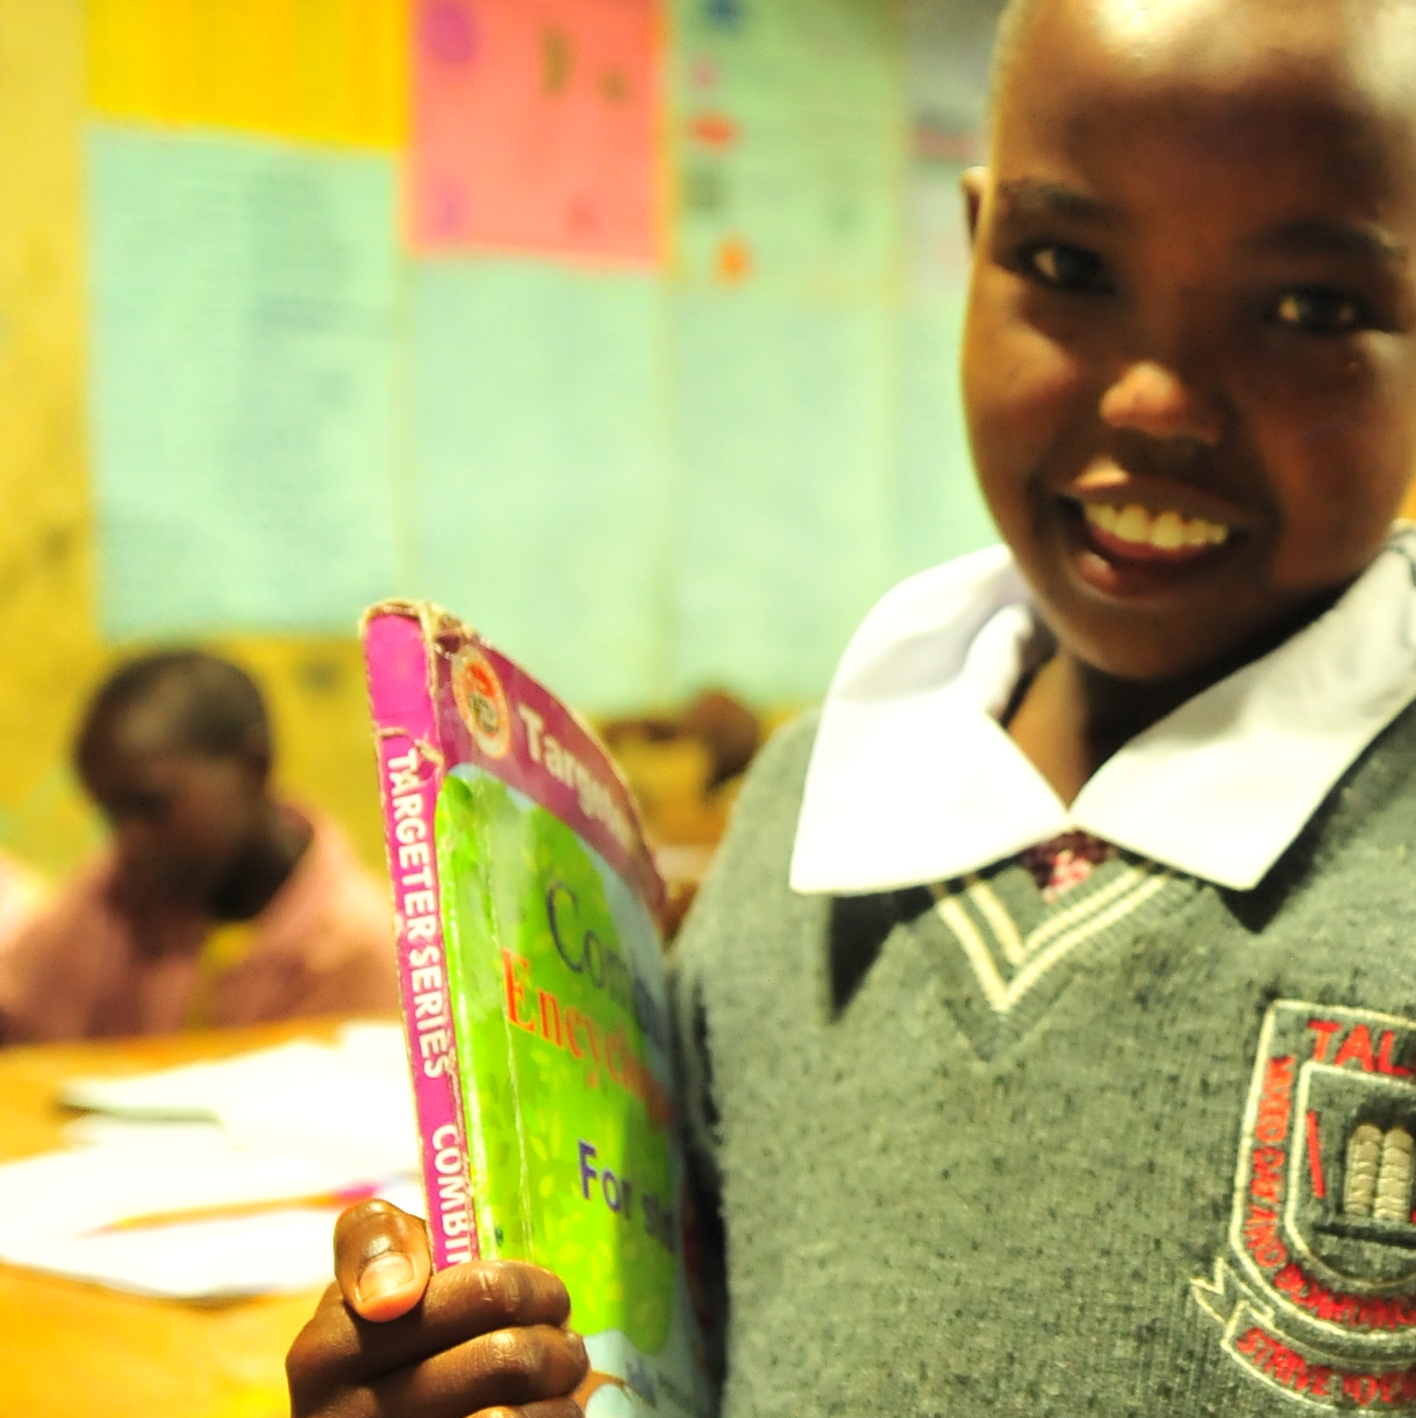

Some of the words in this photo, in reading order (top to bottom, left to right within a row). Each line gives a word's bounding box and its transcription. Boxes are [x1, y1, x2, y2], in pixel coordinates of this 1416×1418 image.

[386, 748, 436, 942] TARGETER
[408, 947, 450, 1079] SERIES
[577, 1137, 632, 1221] For
